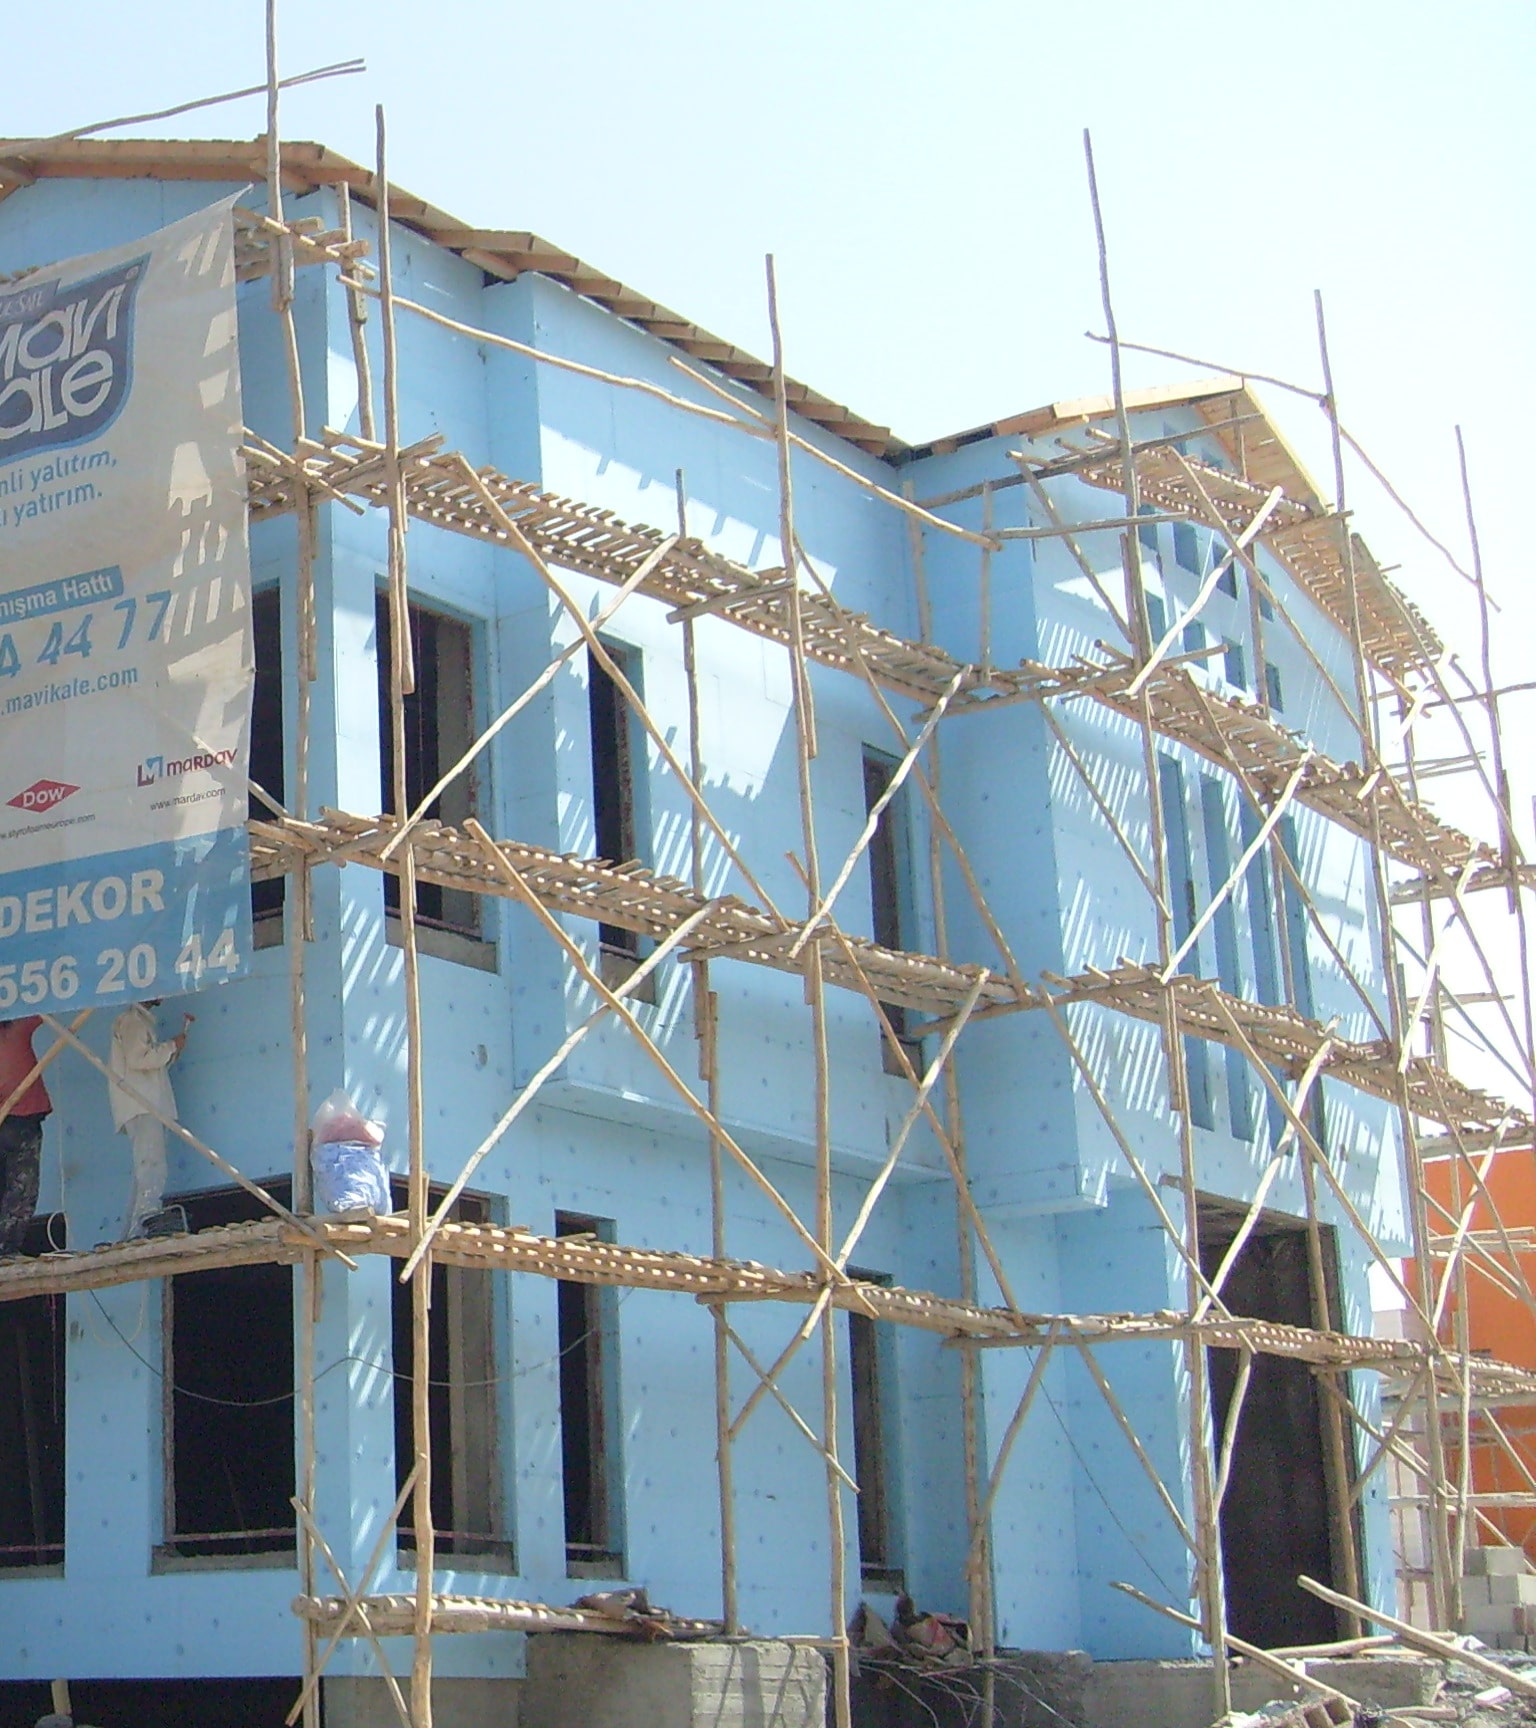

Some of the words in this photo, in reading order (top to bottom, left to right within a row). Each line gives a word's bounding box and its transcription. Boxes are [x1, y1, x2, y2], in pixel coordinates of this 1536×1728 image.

[63, 575, 114, 606] Hattı
[36, 614, 93, 666] 44
[113, 590, 172, 650] 77
[95, 942, 157, 995] 20
[174, 926, 240, 977] 44
